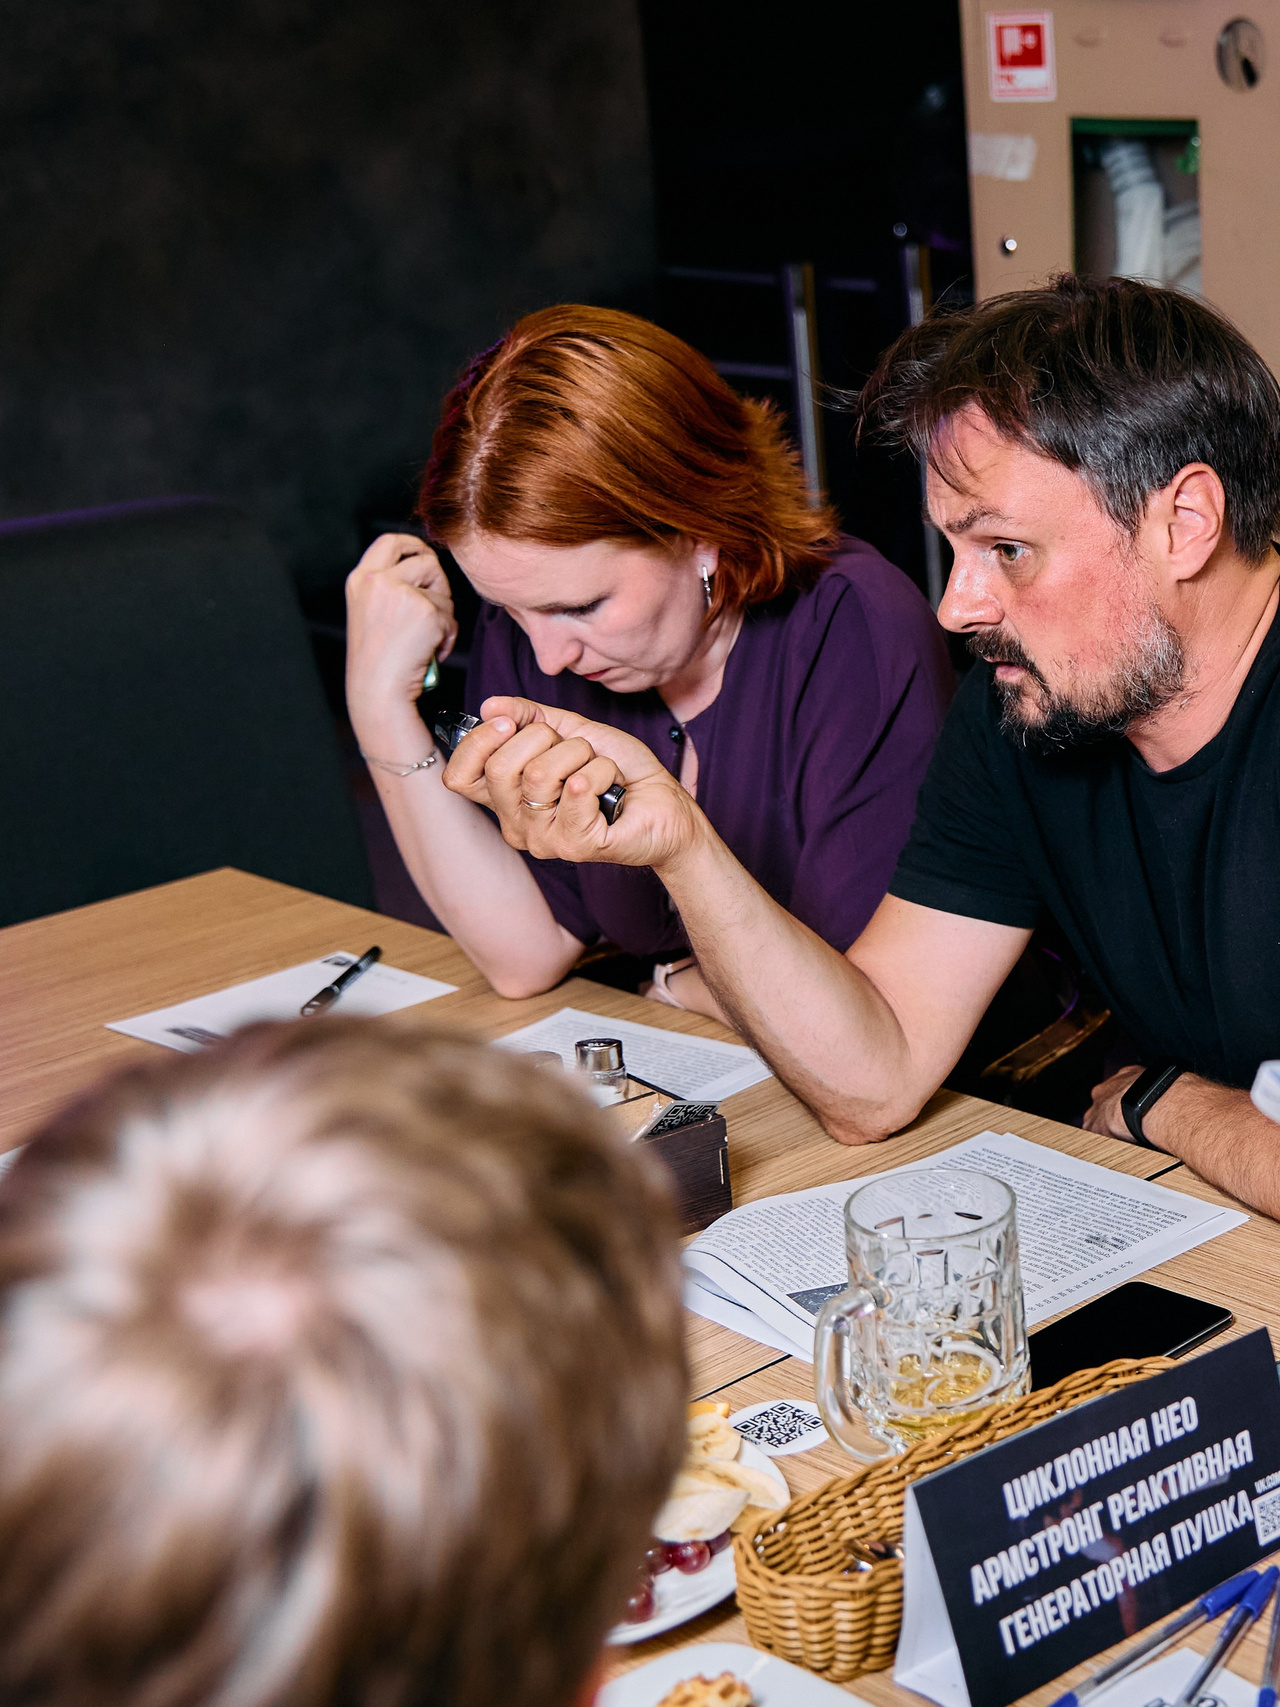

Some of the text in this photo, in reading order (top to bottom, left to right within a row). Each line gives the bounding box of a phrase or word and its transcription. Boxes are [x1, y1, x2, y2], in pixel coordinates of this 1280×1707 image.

[970, 1429, 1254, 1606] АРМСТРОНГ РЕАКТИВНАЯ
[1003, 1396, 1198, 1521] ЦИКЛОННАЯ НЕО
[999, 1489, 1254, 1657] ГЕНЕРАТОРНАЯ ПУШКА
